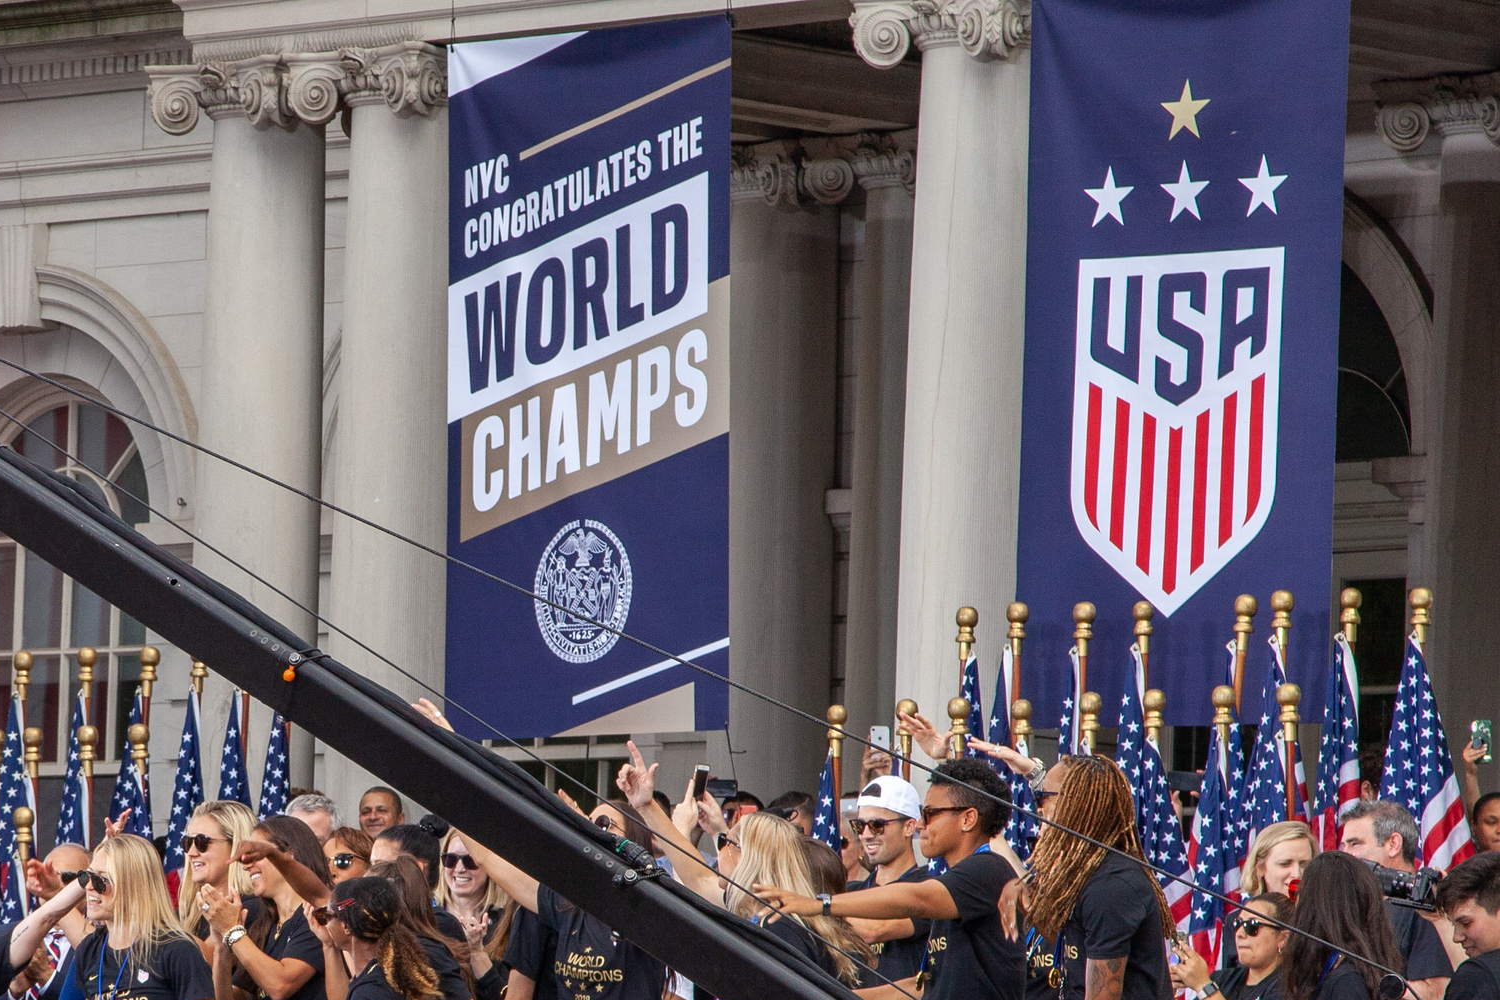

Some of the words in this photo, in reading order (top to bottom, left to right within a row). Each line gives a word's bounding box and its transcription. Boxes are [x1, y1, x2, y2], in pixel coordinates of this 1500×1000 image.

[464, 139, 652, 259] CONGRATULATES
[657, 115, 703, 172] THE
[465, 153, 510, 208] NYC
[464, 203, 690, 394] WORLD
[1090, 266, 1271, 407] USA
[473, 329, 708, 512] CHAMPS
[572, 630, 592, 640] 1625
[554, 961, 624, 982] CHAMPIONS
[568, 952, 606, 968] WORLD
